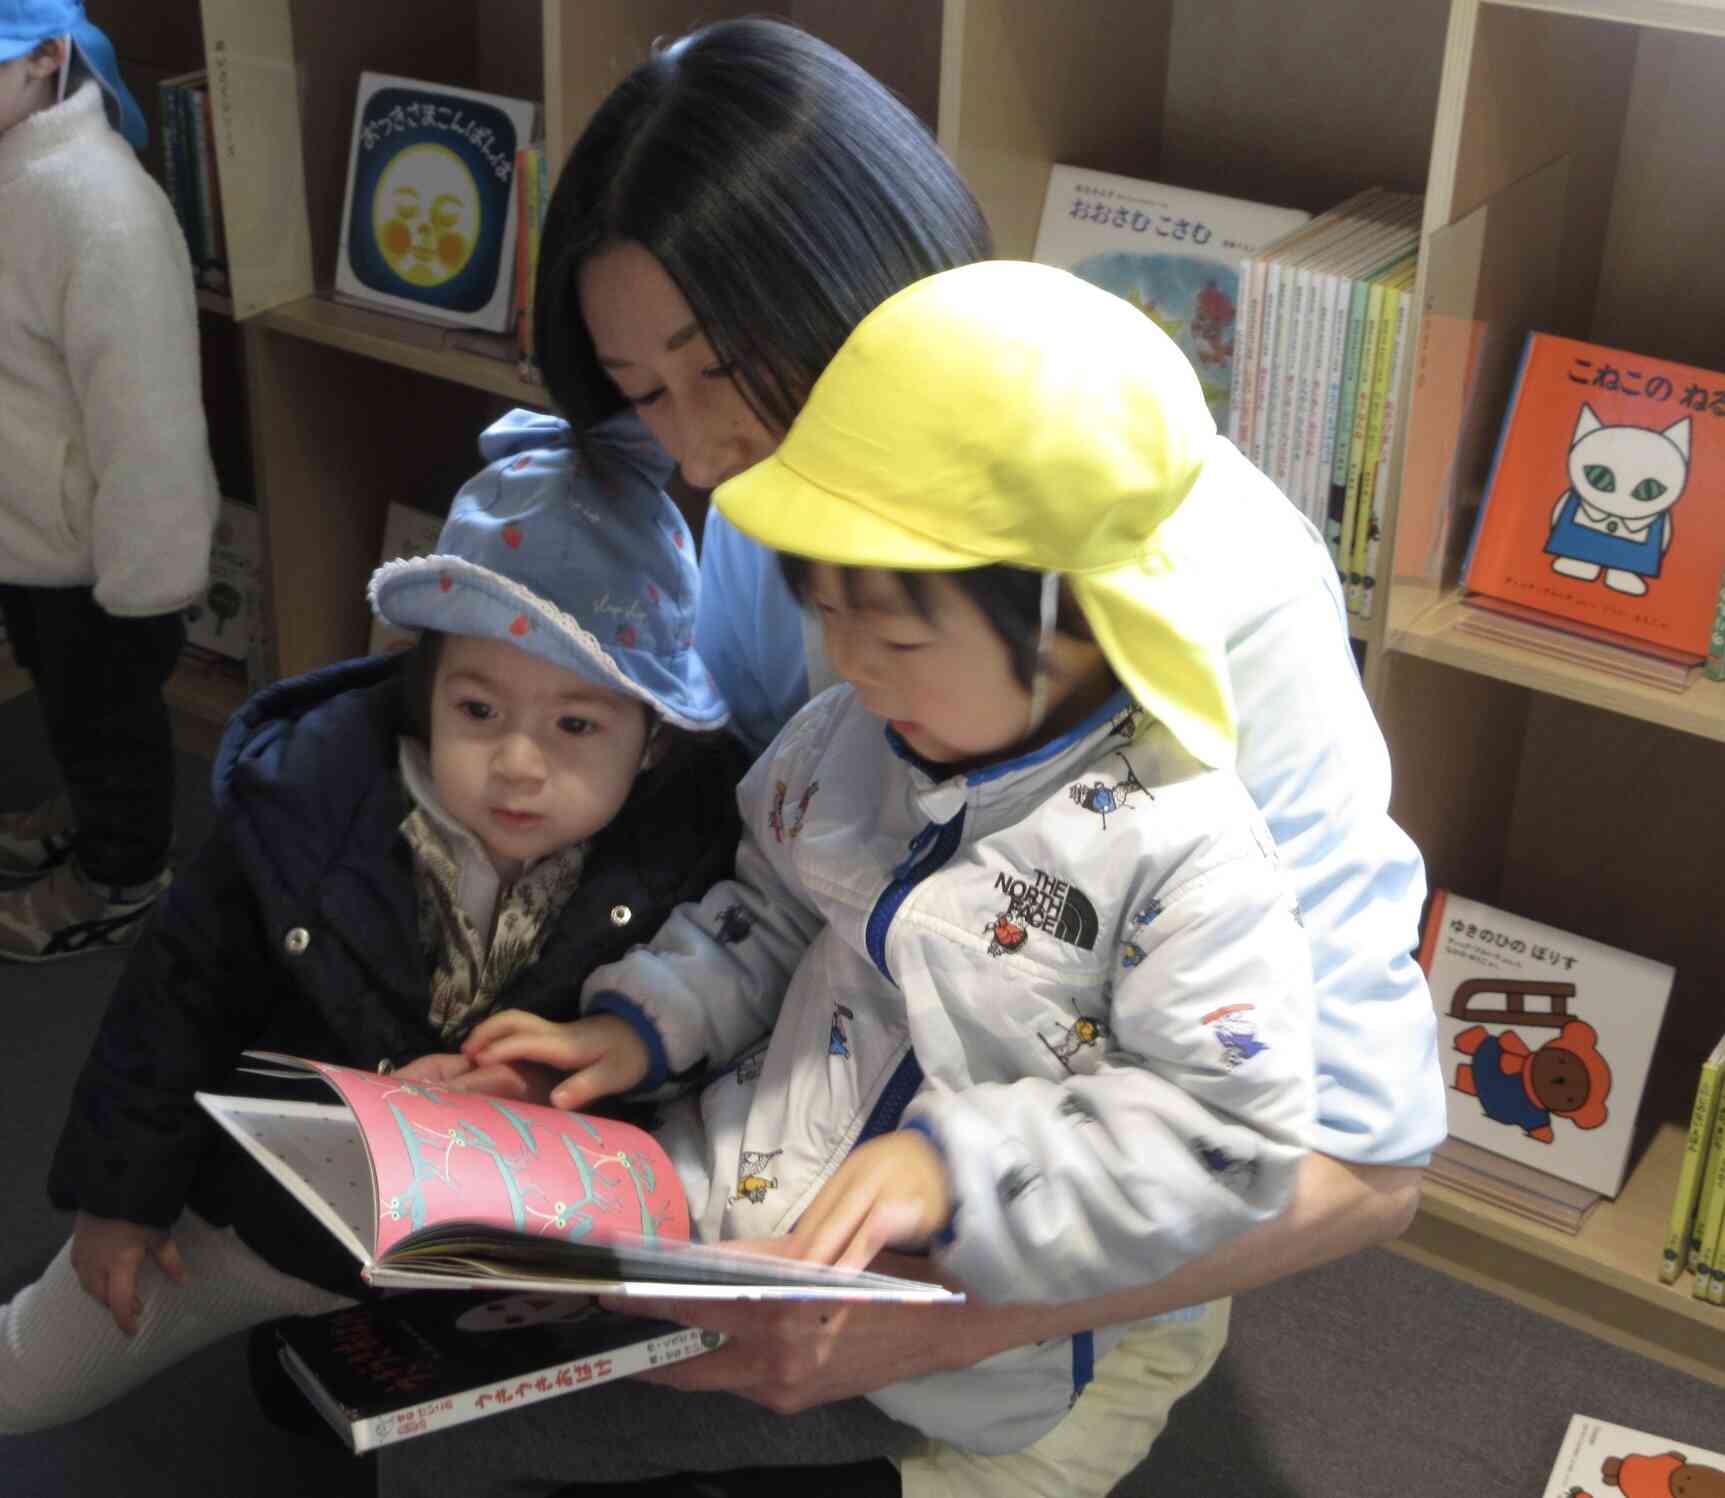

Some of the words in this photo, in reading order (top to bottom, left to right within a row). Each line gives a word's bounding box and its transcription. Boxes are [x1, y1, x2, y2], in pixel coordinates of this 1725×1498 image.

[361, 101, 511, 182] おつきさまこんばんは
[1069, 198, 1151, 232] おおさむ
[1155, 215, 1213, 244] こさむ
[1568, 358, 1672, 402] こねこの
[994, 872, 1064, 922] NORTH
[1033, 868, 1068, 900] THE
[1449, 918, 1527, 954] ゆきのひの
